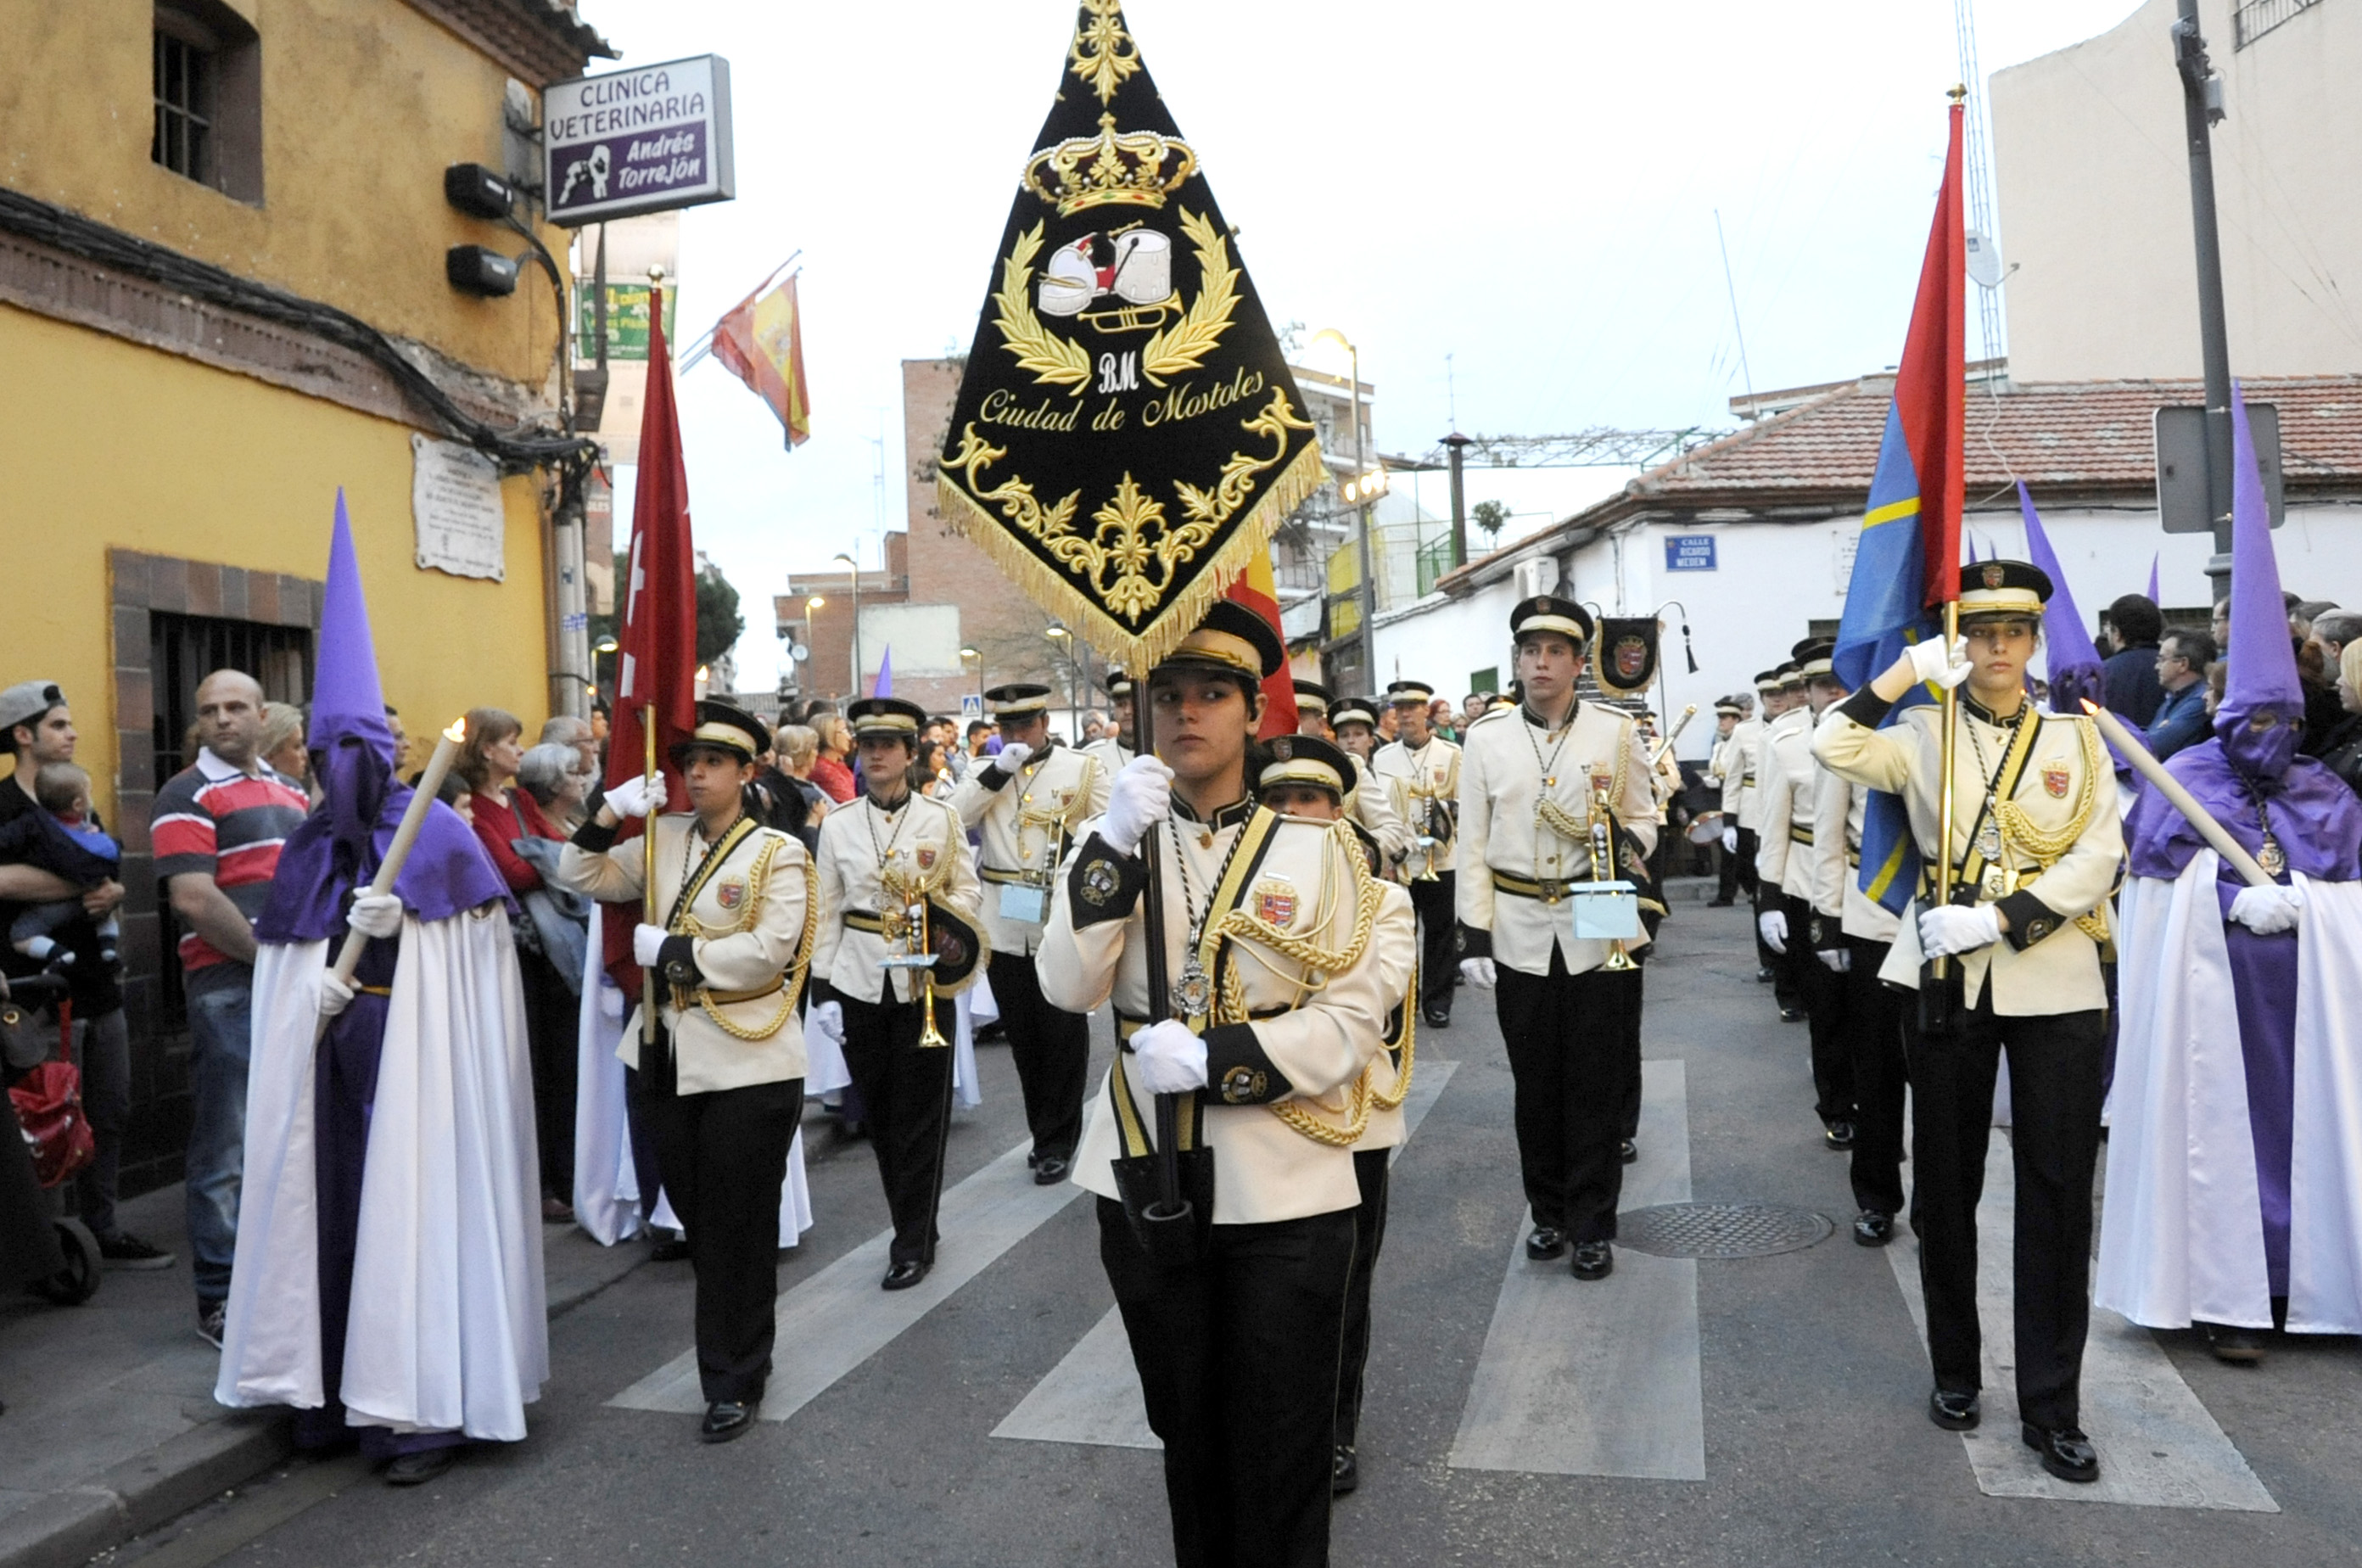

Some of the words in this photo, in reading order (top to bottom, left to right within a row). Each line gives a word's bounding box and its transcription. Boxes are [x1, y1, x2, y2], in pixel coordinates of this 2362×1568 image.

[580, 71, 669, 107] CLINICA
[550, 92, 705, 140] VETERINARIA
[627, 131, 695, 162] Andrés
[618, 157, 702, 188] Torrejón
[979, 388, 1083, 432] Ciudad
[1091, 397, 1125, 432] de
[1142, 367, 1263, 427] Mostoles
